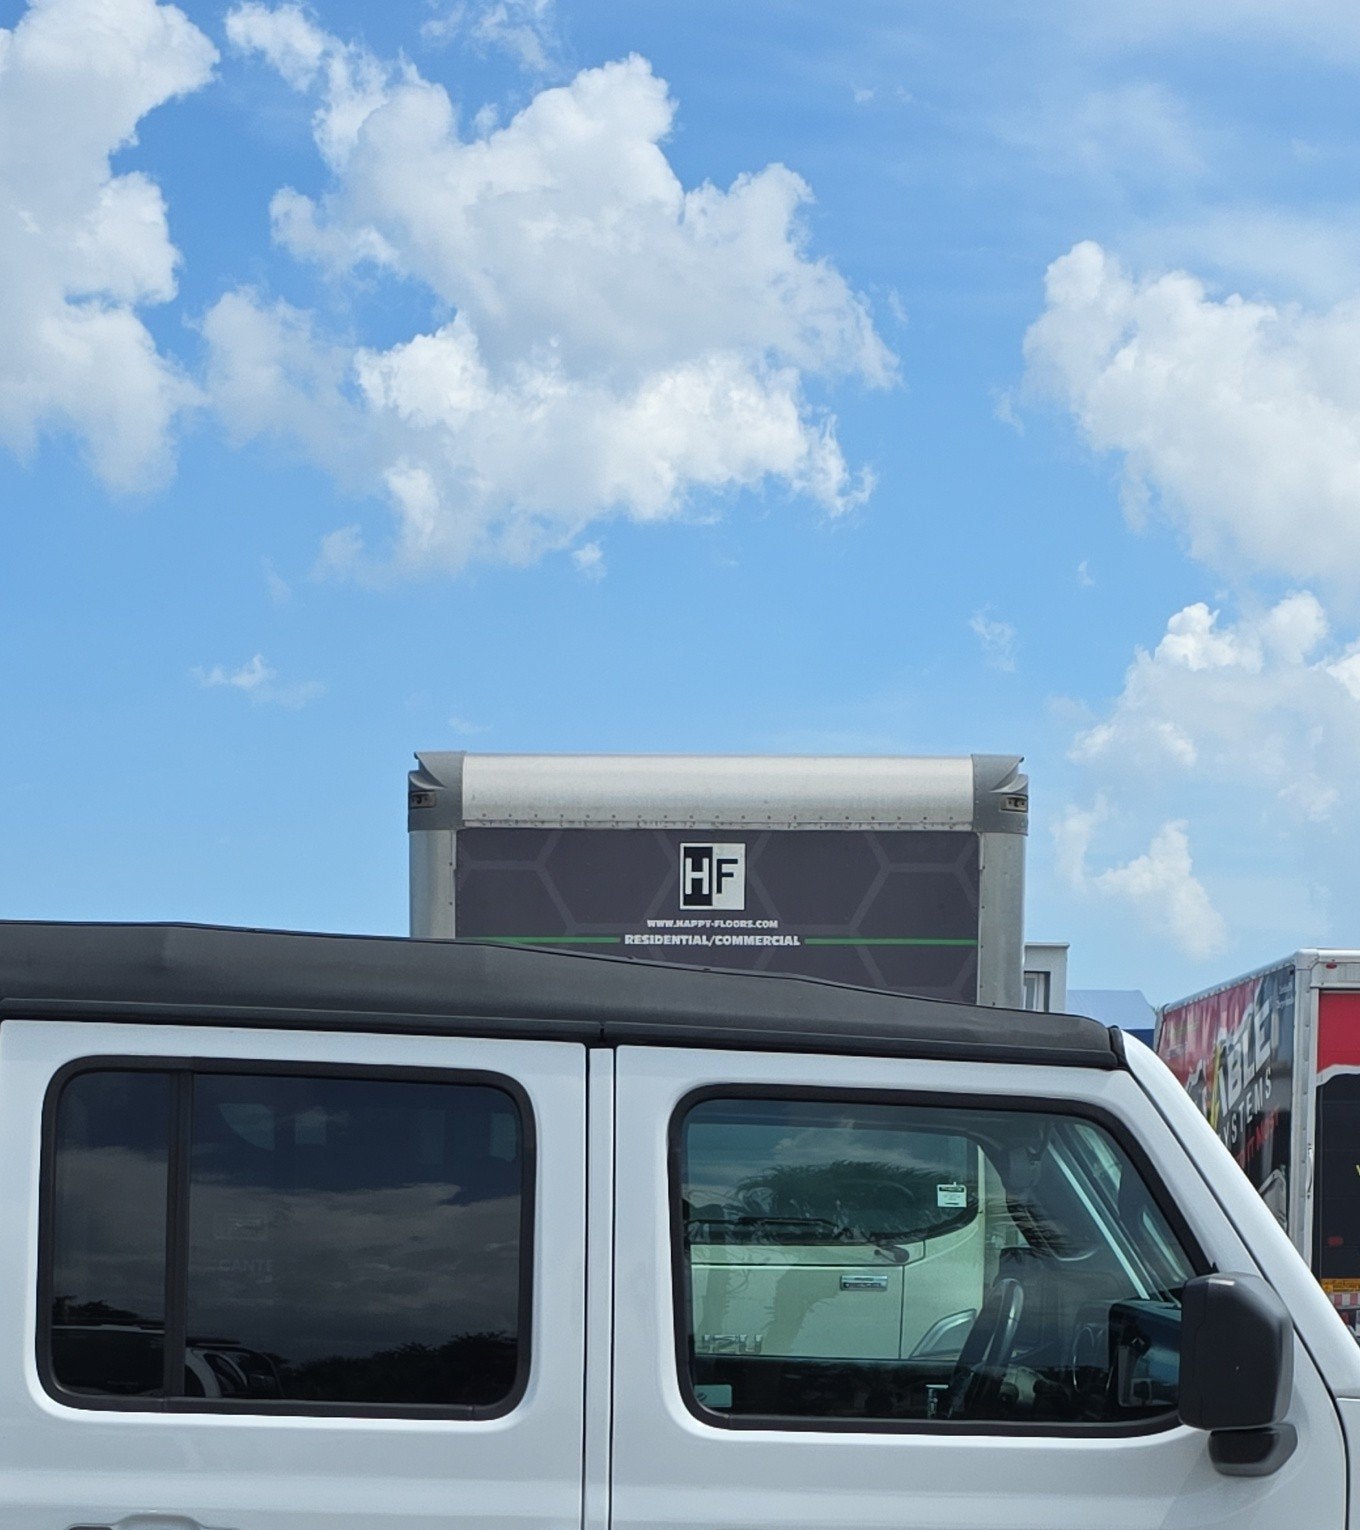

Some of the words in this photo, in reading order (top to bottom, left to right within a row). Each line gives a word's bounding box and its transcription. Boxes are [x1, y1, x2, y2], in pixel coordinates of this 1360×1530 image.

[684, 857, 739, 895] HF
[647, 919, 779, 929] WWW.HAPPY-FLOORS.COM
[624, 934, 802, 947] RESIDENTIAL/COMMERCIAL
